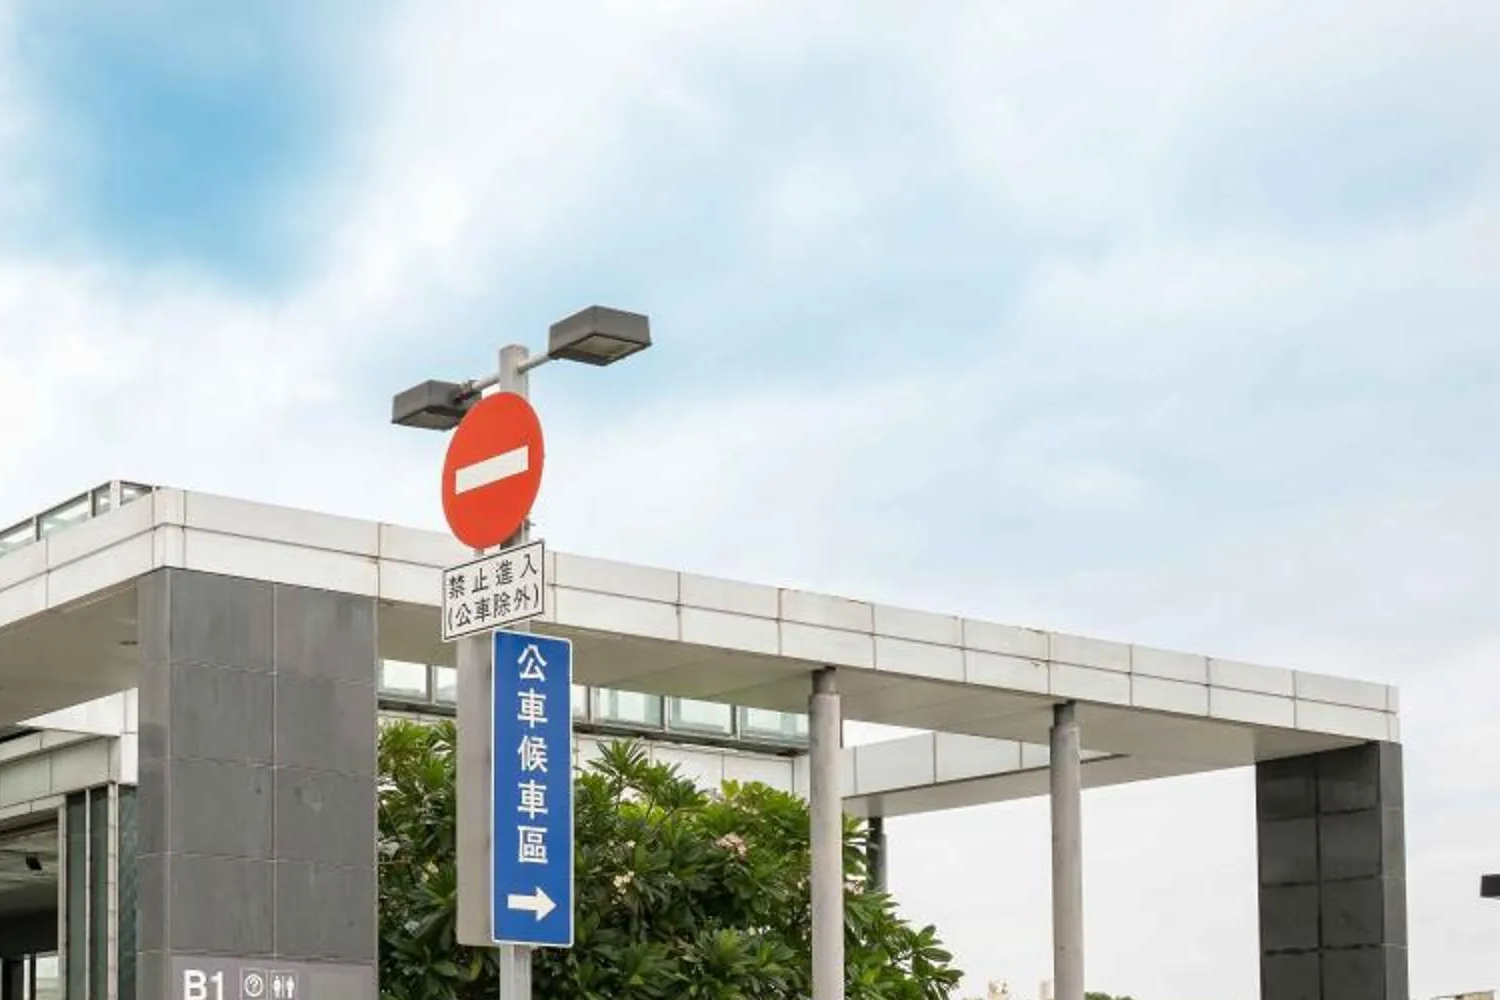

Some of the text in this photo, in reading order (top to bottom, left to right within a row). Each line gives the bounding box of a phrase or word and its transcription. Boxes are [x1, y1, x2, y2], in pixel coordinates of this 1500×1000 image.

[449, 553, 538, 600] 禁止進入
[447, 583, 539, 632] (公車除外)
[517, 643, 549, 865] 公車候車區
